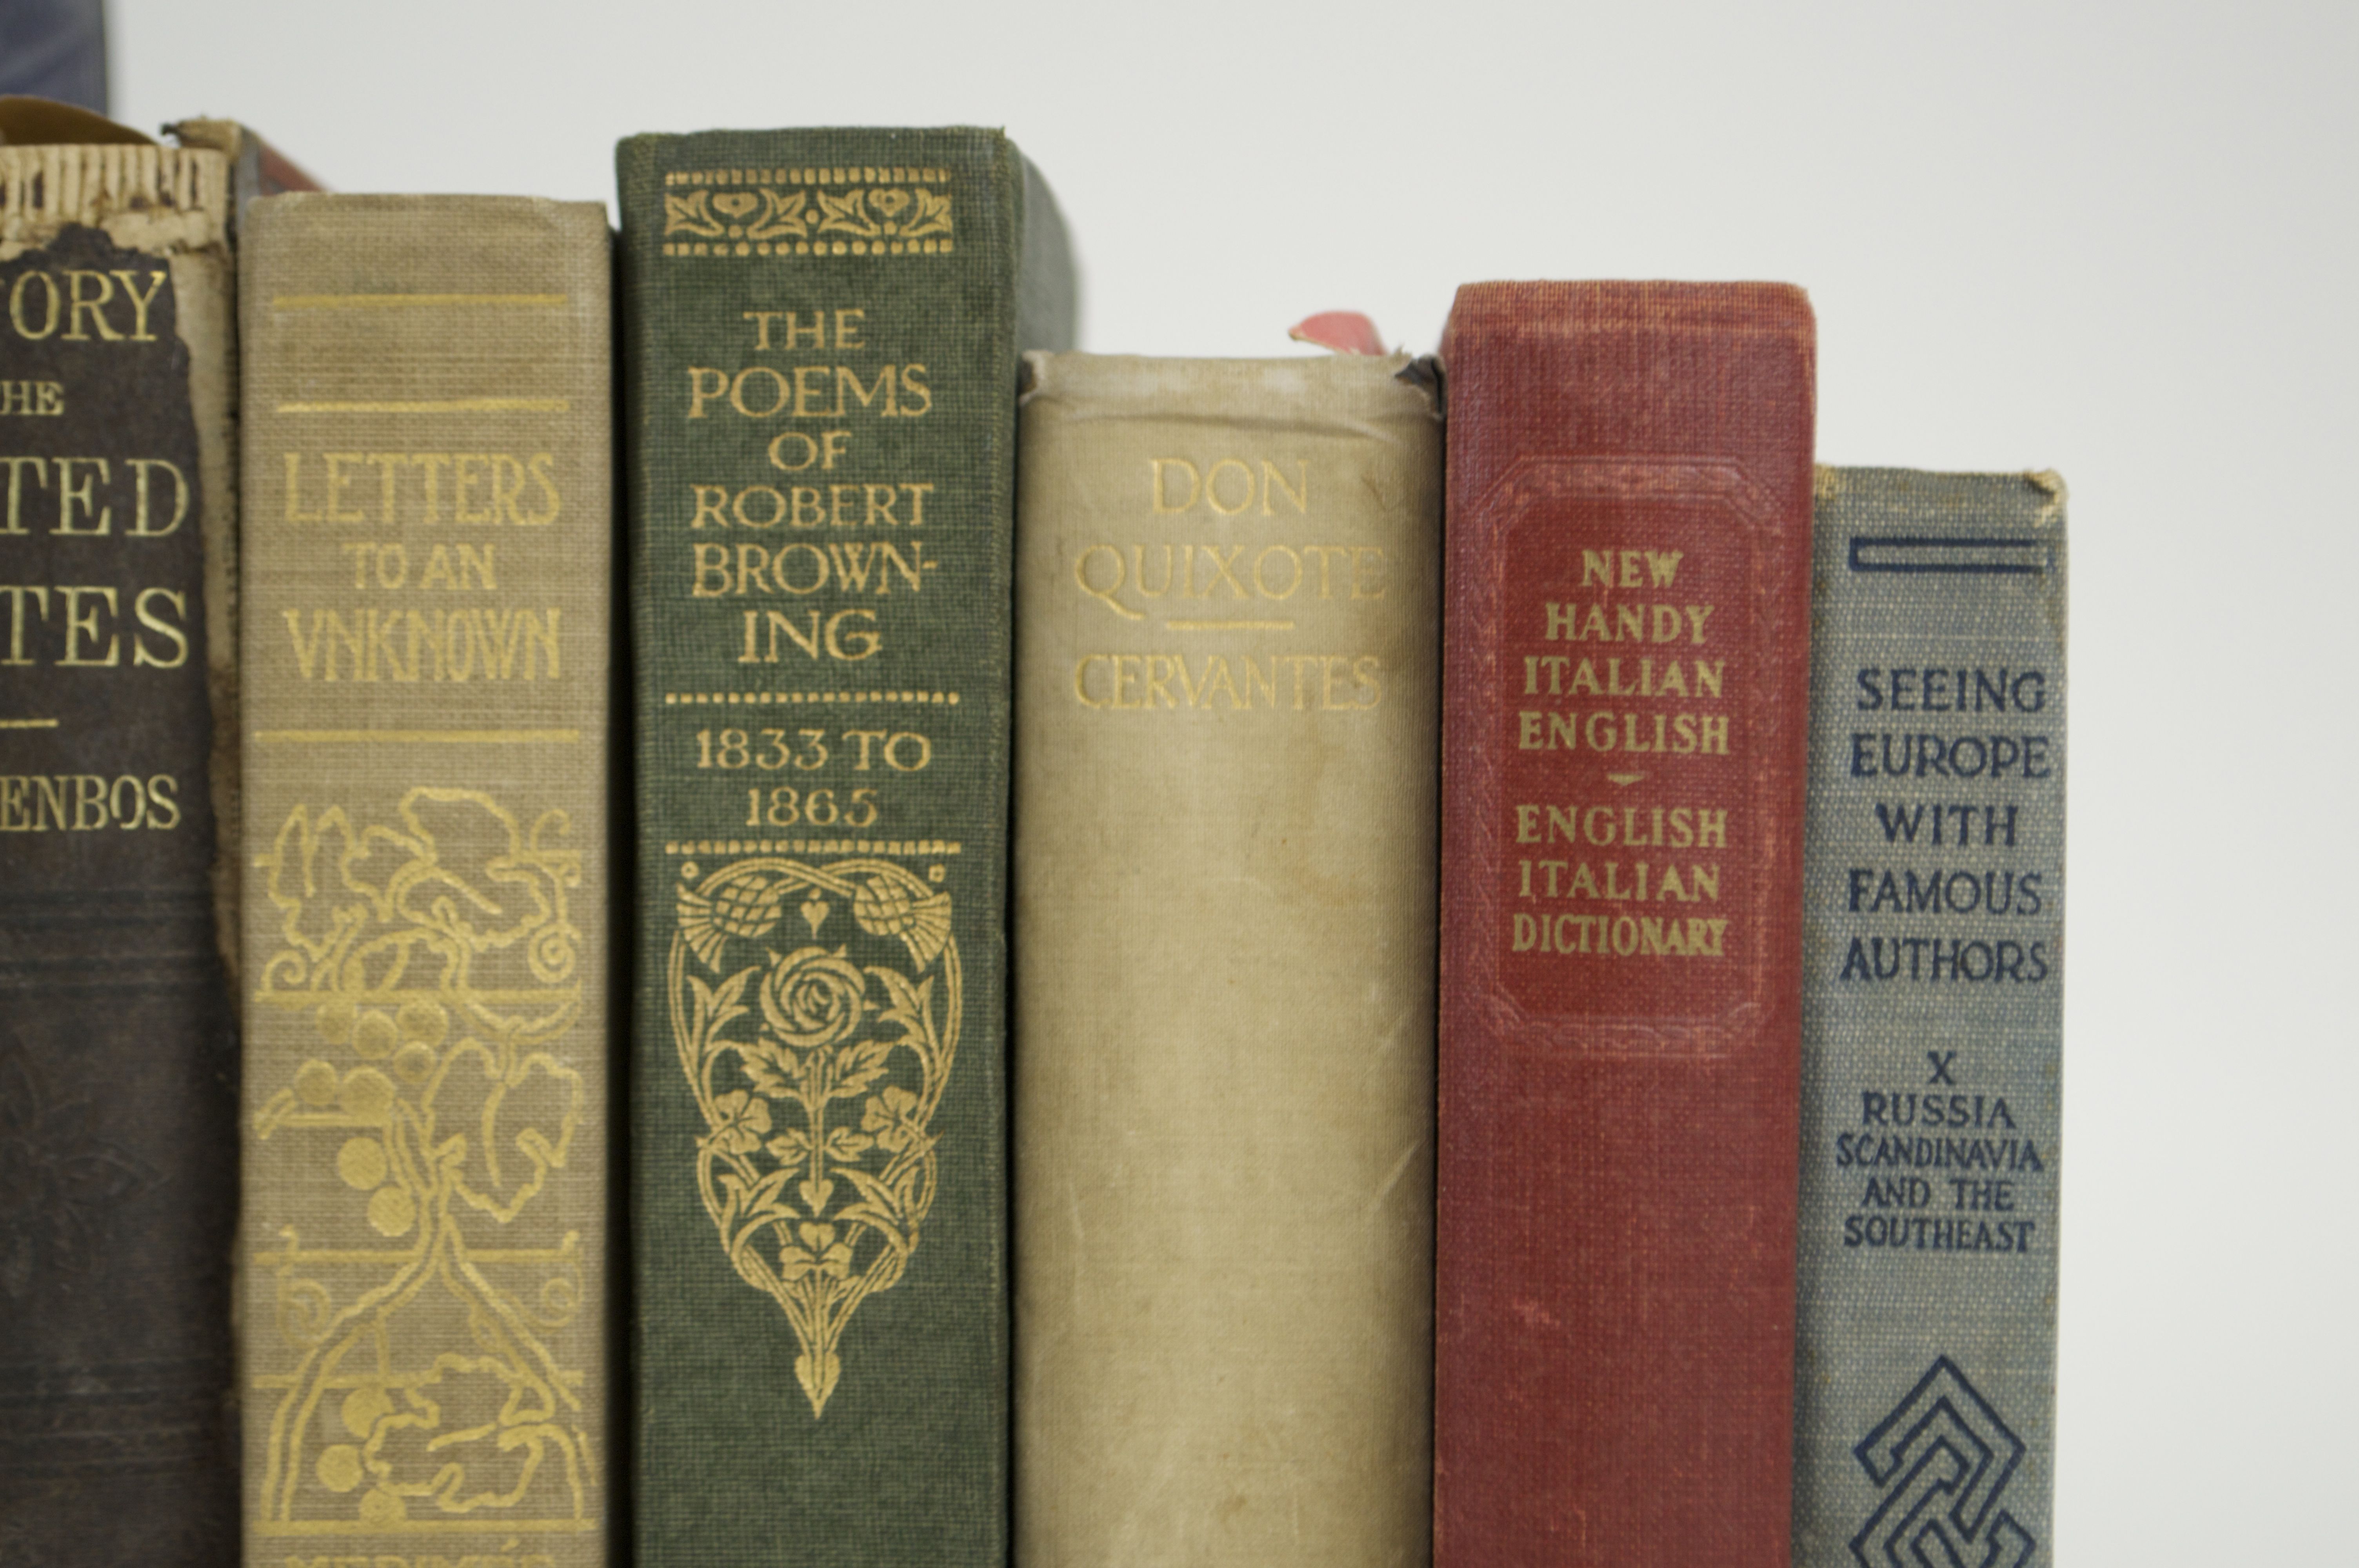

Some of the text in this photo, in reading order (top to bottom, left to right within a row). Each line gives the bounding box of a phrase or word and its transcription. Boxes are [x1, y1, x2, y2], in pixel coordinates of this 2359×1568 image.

[0, 269, 167, 341] ORY
[743, 308, 865, 350] THE
[687, 363, 932, 419] POEMS
[768, 430, 852, 471] OF
[0, 457, 190, 536] TED
[284, 452, 561, 525] LETTERS
[691, 483, 934, 528] ROBERT
[1150, 458, 1309, 517] DON
[342, 542, 497, 590] TO AN
[692, 541, 939, 597] BROWN-
[1074, 544, 1385, 620] QUIXOTE
[1580, 549, 1684, 588] NEW
[0, 586, 189, 668] TES
[282, 608, 561, 682] VNKNOWN
[738, 609, 883, 663] ING
[1545, 601, 1716, 645] HANDY
[1074, 654, 1383, 711] CERVANTES
[1524, 655, 1725, 699] ITALIAN
[1857, 668, 2047, 713] SEEING
[696, 728, 932, 771] 1833 TO
[1518, 710, 1730, 755] ENGLISH
[1850, 732, 2052, 779] EUROPE
[0, 774, 182, 830] ENBOS
[746, 786, 878, 827] 1865
[1874, 802, 2019, 847] WITH
[1516, 804, 1728, 848] ENGLISH
[1518, 860, 1721, 902] ITALIAN
[1848, 868, 2043, 916] FAMOUS
[1512, 913, 1730, 956] DICTIONARY
[1839, 936, 2048, 982] AUTHORS
[1927, 1050, 1957, 1085] X
[1862, 1090, 2017, 1129] RUSSIA
[1836, 1132, 2044, 1172] SCANDINAVIA
[1861, 1177, 2016, 1212] AND THE
[1844, 1214, 2037, 1253] SOUTHEAST
